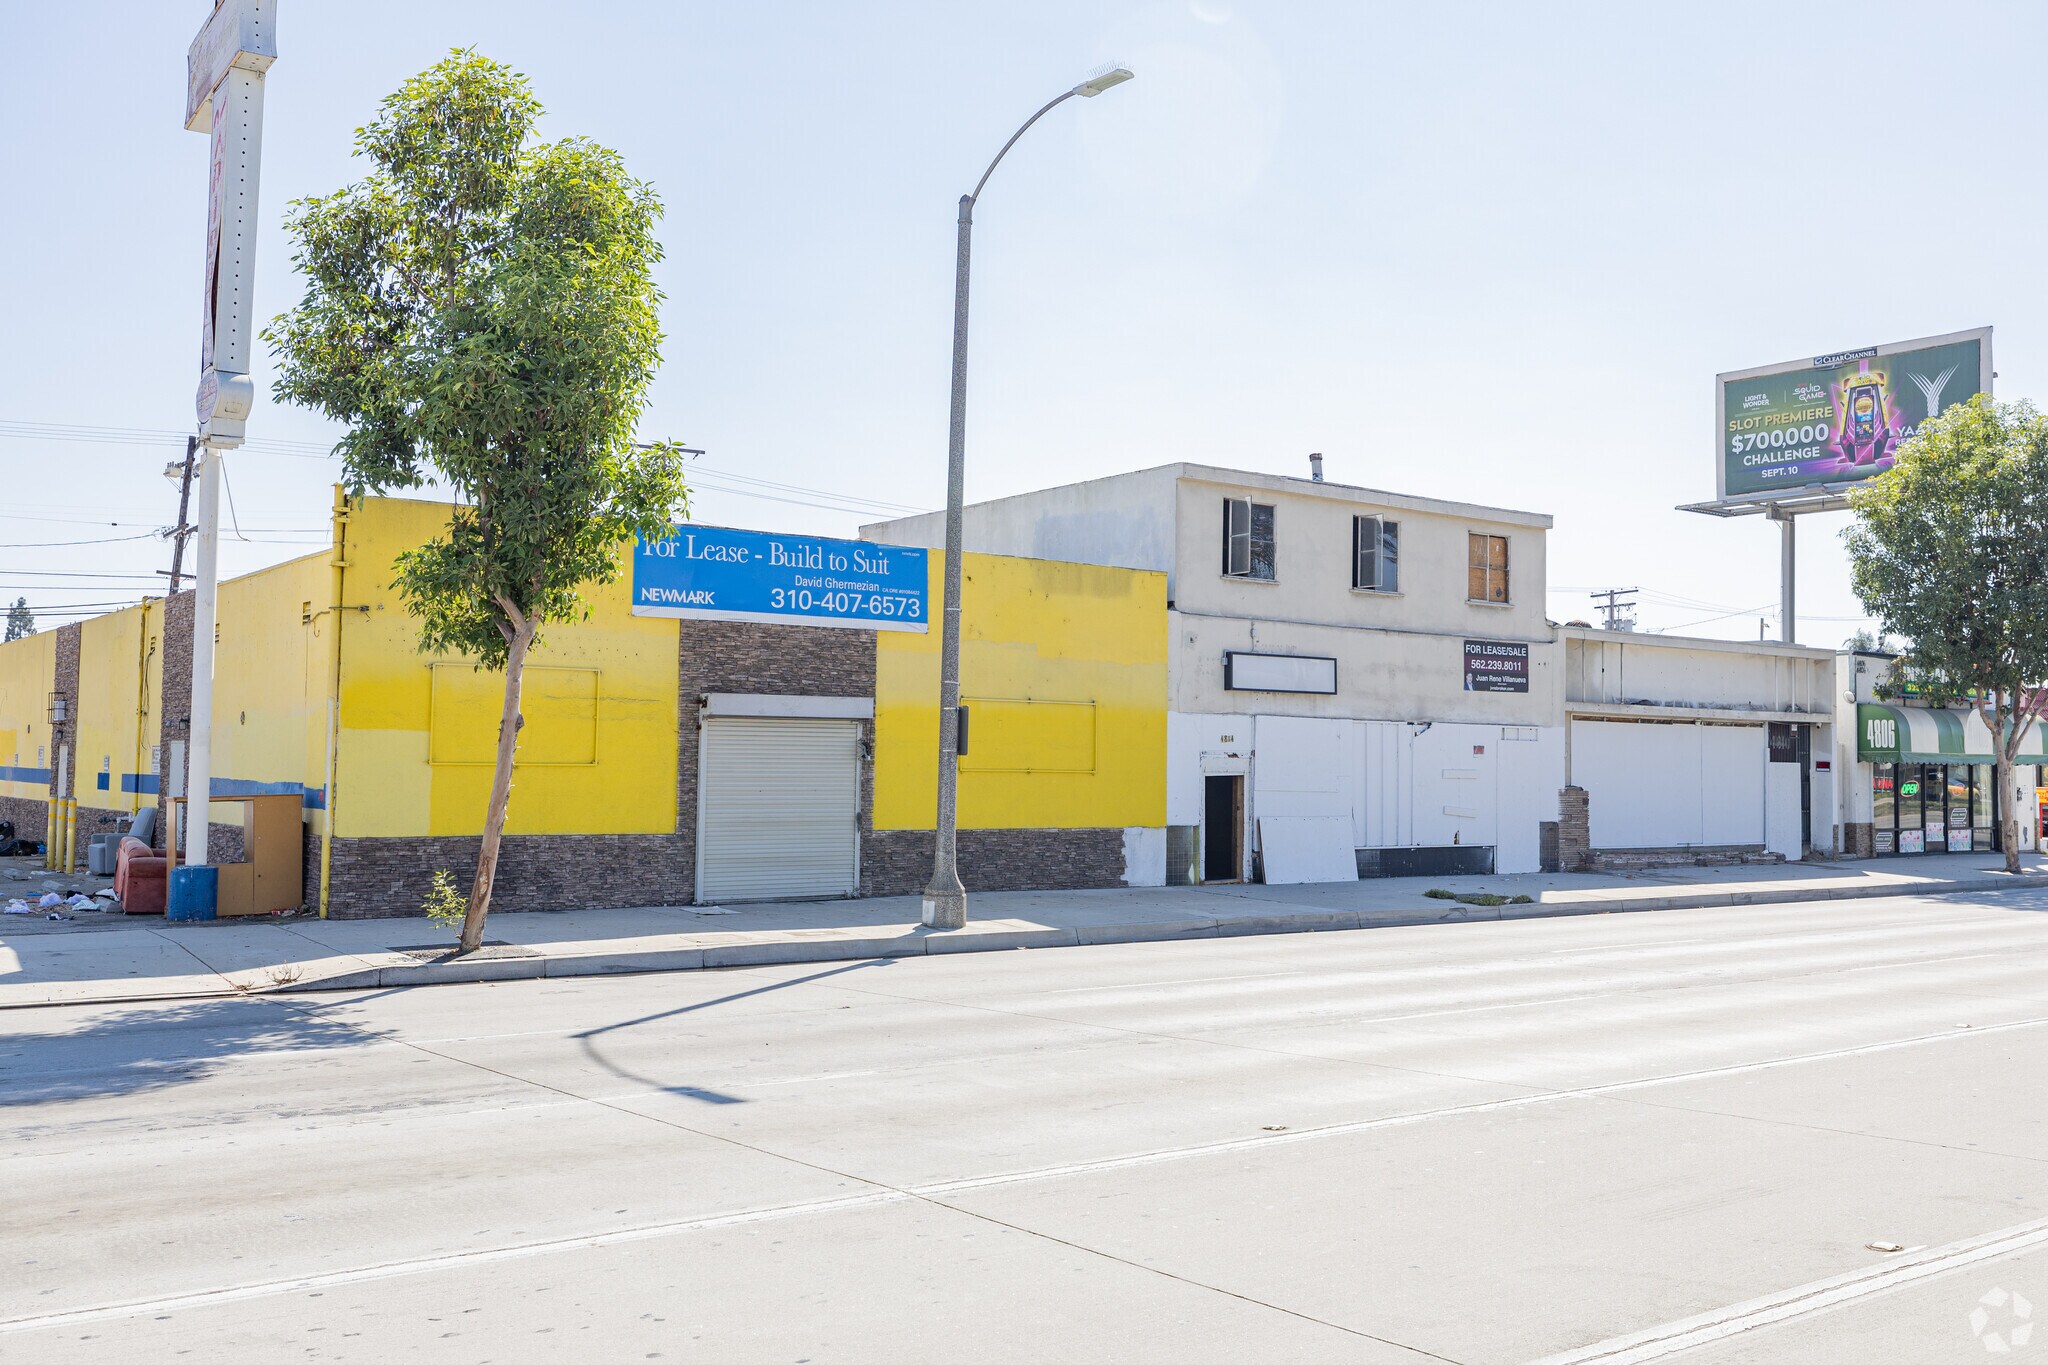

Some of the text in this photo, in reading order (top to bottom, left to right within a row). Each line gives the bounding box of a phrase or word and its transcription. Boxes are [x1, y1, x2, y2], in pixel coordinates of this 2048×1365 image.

[1743, 399, 1770, 409] WONDER
[1744, 394, 1762, 402] LIGHT
[1799, 391, 1827, 402] GAME
[1729, 406, 1833, 432] SLOT PREMIERE
[1731, 423, 1829, 454] $700,000
[1743, 446, 1820, 466] CHALLENGE
[1761, 466, 1798, 478] SEPT. 10
[685, 534, 749, 564] Lease
[768, 542, 823, 570] Build
[829, 551, 848, 571] to
[853, 549, 890, 575] Suit
[795, 575, 822, 588] David
[825, 577, 880, 592] Ghermezian
[641, 587, 715, 605] NEWMARK
[771, 588, 920, 618] 310-407-6573
[1465, 644, 1527, 657] FOR LEASE/SALE
[1471, 659, 1521, 671] 562.239.8011
[1476, 674, 1488, 682] Juan
[1502, 675, 1526, 683] Villanueva
[1867, 719, 1896, 749] 4806
[1901, 783, 1918, 794] OPEN
